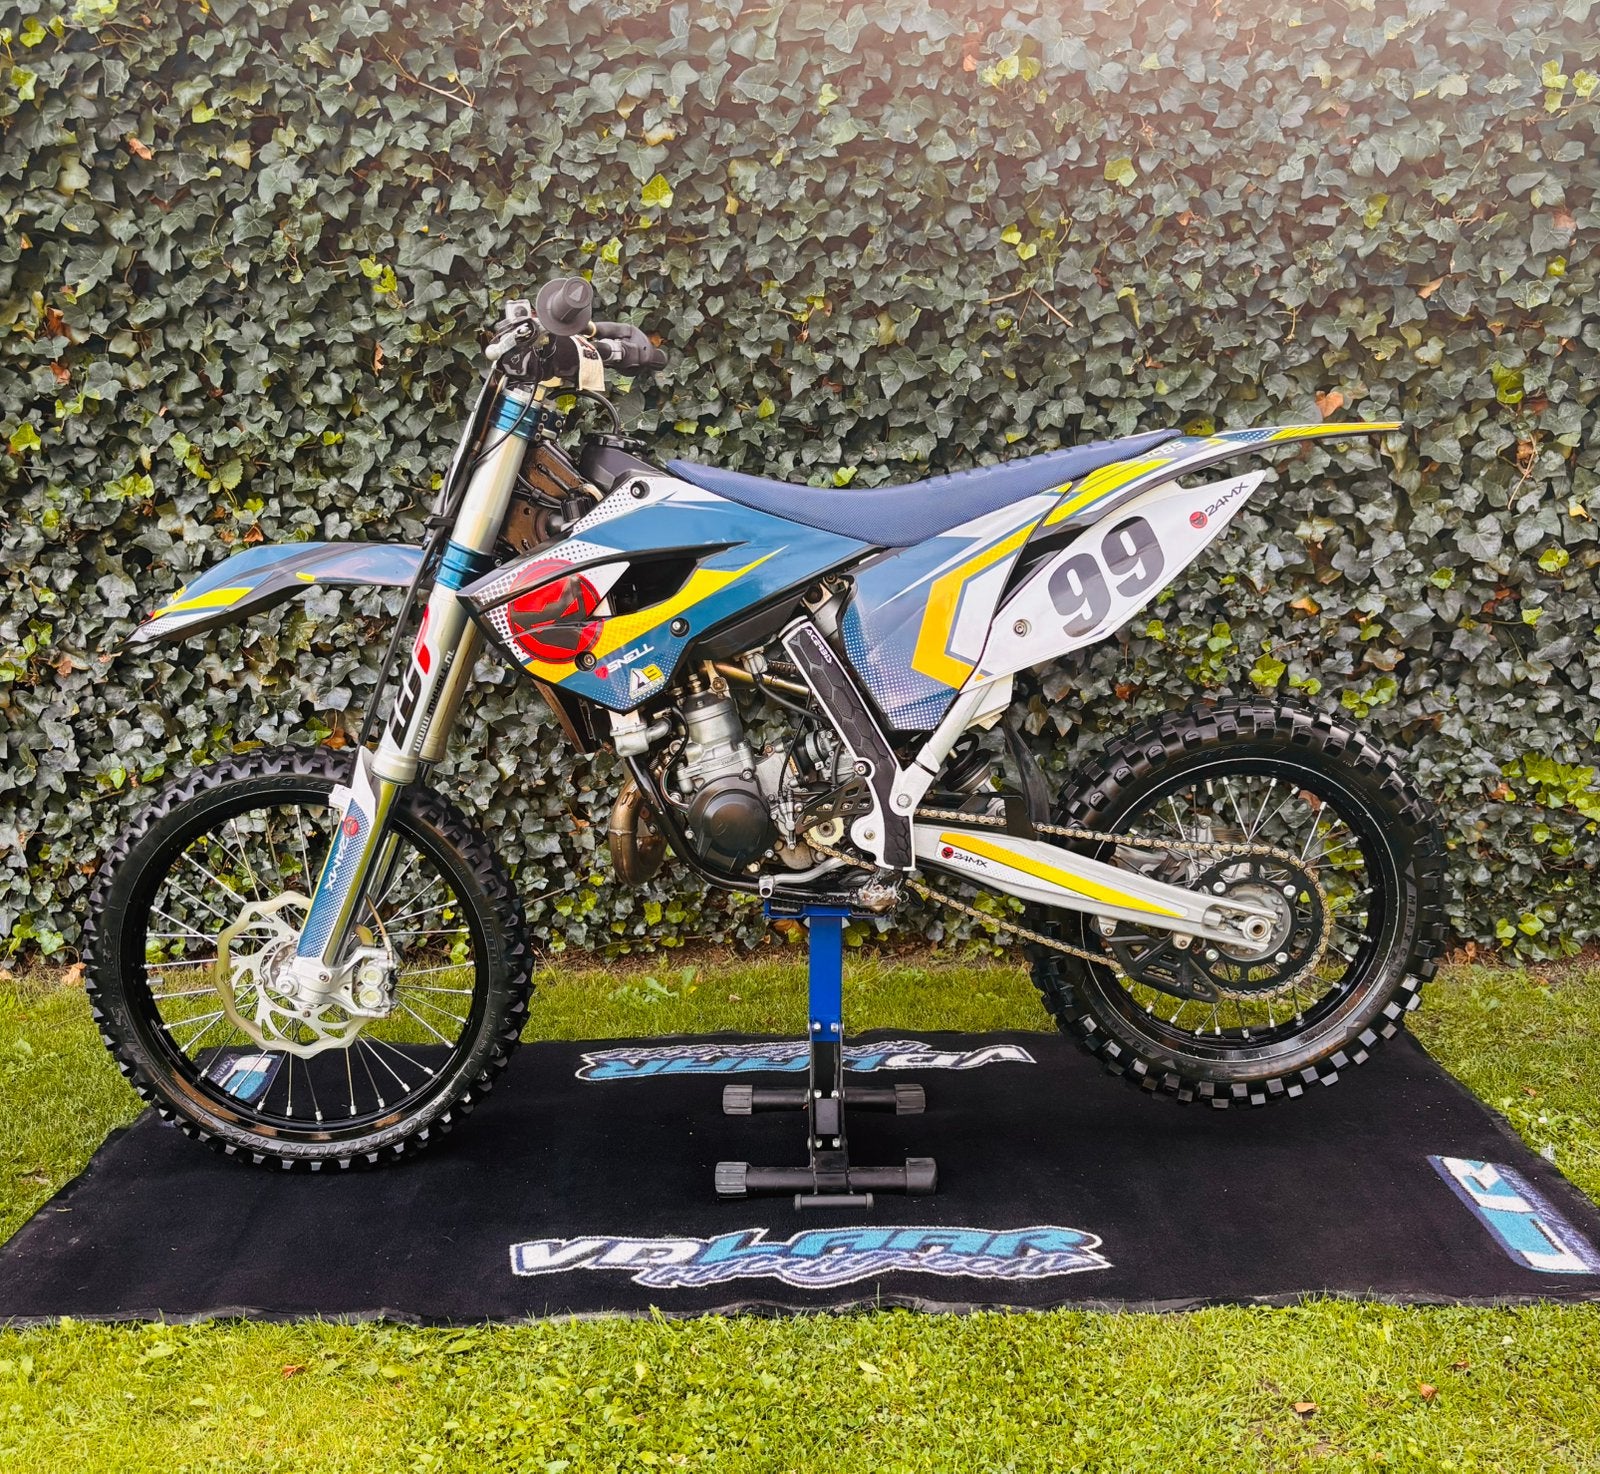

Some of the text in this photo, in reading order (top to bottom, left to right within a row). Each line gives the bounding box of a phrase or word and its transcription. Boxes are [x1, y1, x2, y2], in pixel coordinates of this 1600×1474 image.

[1205, 482, 1249, 517] 24MX
[1048, 515, 1165, 638] 99
[804, 627, 833, 664] ACERBIS
[953, 851, 988, 868] 24MX
[514, 1227, 1094, 1272] VDLAAR
